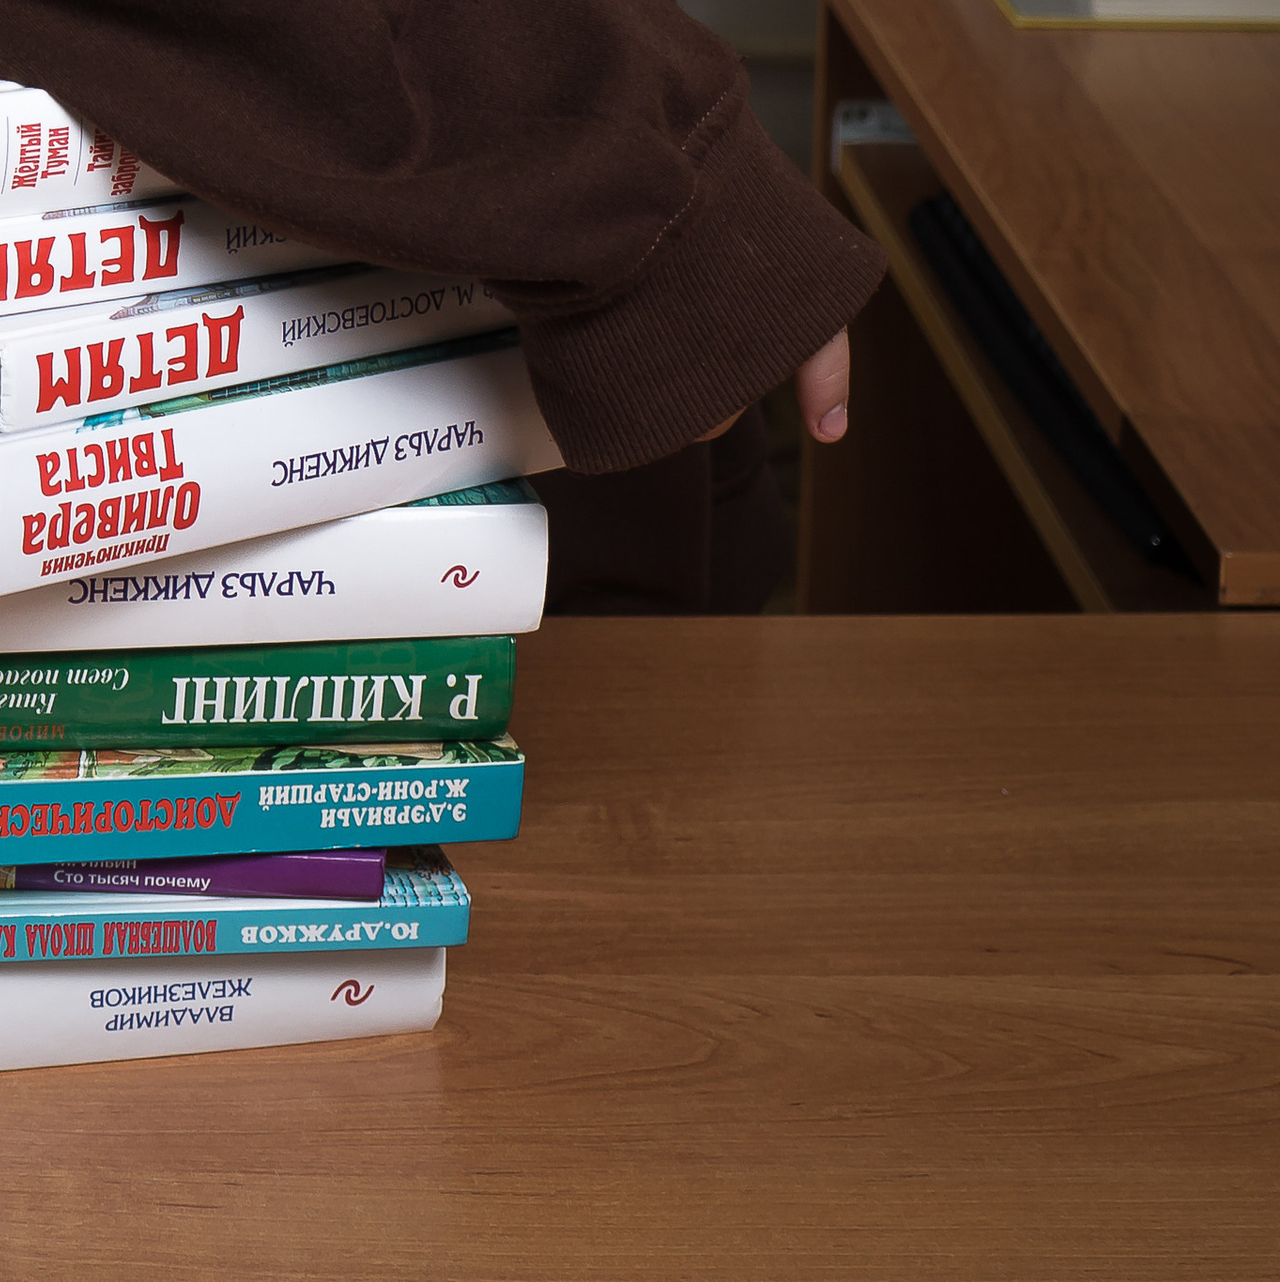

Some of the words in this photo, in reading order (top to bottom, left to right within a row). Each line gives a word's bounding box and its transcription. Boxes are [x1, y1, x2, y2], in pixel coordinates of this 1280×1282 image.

[11, 122, 42, 190] Жёлтый
[40, 126, 70, 180] Туман
[86, 128, 116, 172] Тайн
[281, 285, 444, 349] ДОСТОЕВСКИЙ
[34, 304, 246, 414] ДЕТЯМ
[270, 435, 391, 488] ДИККЕНС
[393, 420, 486, 461] ЧАРЛЬЗ
[35, 428, 185, 498] Твиста
[21, 481, 202, 556] Оливера
[40, 533, 170, 577] Приключения
[67, 570, 217, 606] ДИККЕНС
[220, 569, 337, 599] ЧАРЛЬЗ
[66, 667, 131, 692] Свет
[160, 674, 428, 725] КИПЛИНГ
[446, 673, 484, 722] Р.
[258, 778, 470, 813] Ж.РОНИ-СТАРШИЙ
[53, 869, 84, 884] Сто
[88, 873, 139, 886] тысяч
[144, 875, 212, 891] почему
[25, 922, 96, 959] ШКОЛА
[103, 919, 218, 956] ВОЛШЕБНАЯ
[241, 922, 421, 945] Ю.ДРУЖКОВ
[88, 977, 253, 1010] ЖЕЛЕЗНИКОВ
[104, 1004, 235, 1033] ВЛАДИМИР
